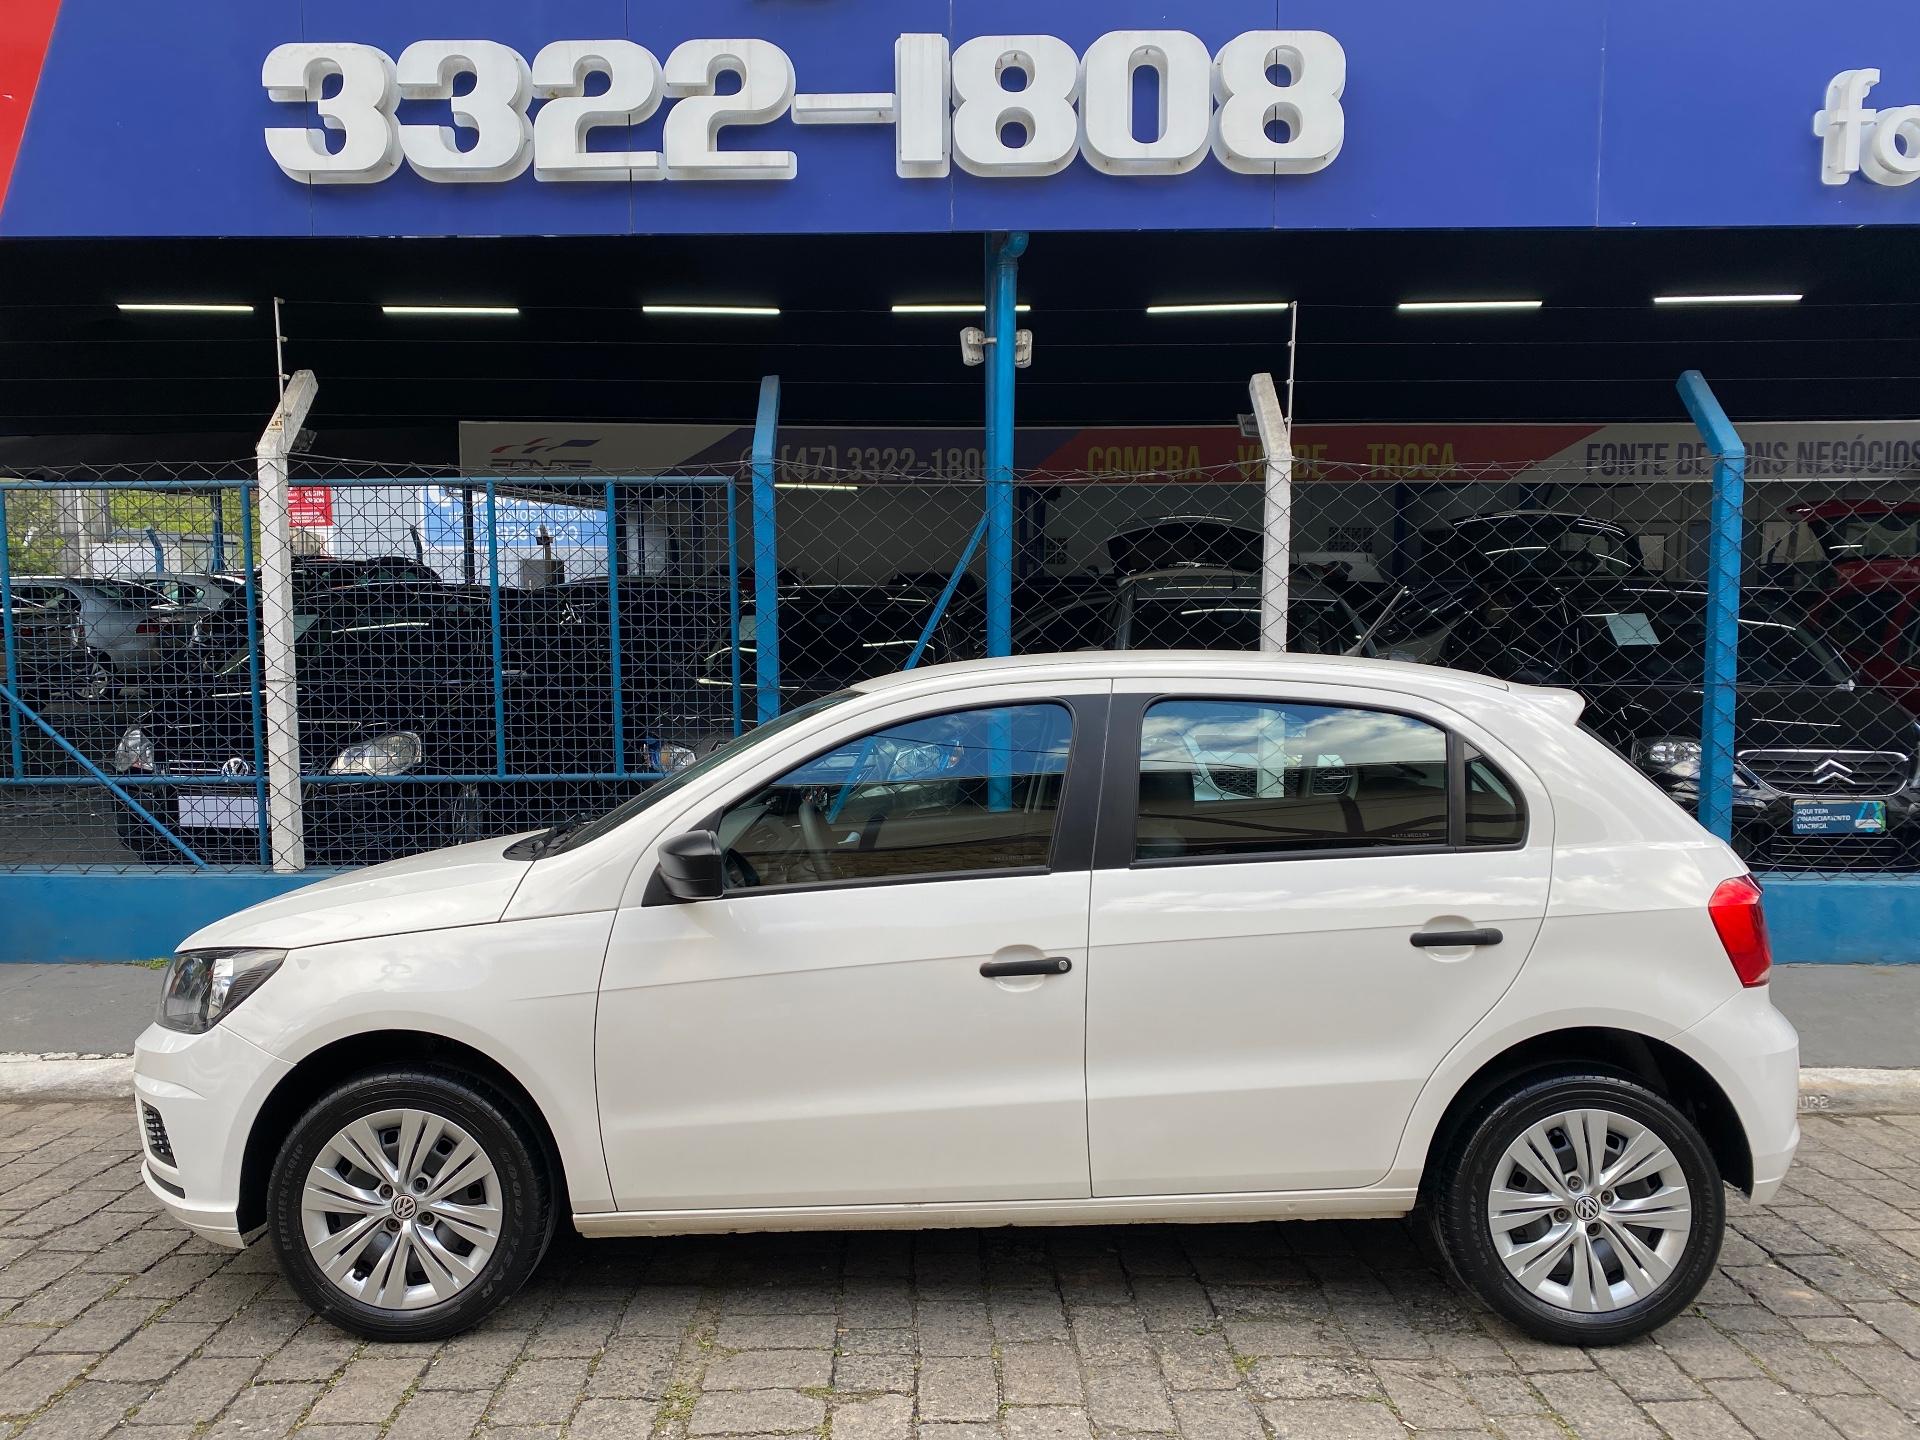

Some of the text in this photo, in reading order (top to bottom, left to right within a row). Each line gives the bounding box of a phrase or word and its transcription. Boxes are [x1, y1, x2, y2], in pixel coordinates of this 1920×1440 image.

[262, 29, 1347, 185] 3322-1808
[781, 444, 837, 482] (47)
[1087, 443, 1456, 481] COMPRA VEDE TROCA
[1586, 443, 1669, 476] FONTE
[1677, 443, 1711, 476] DE
